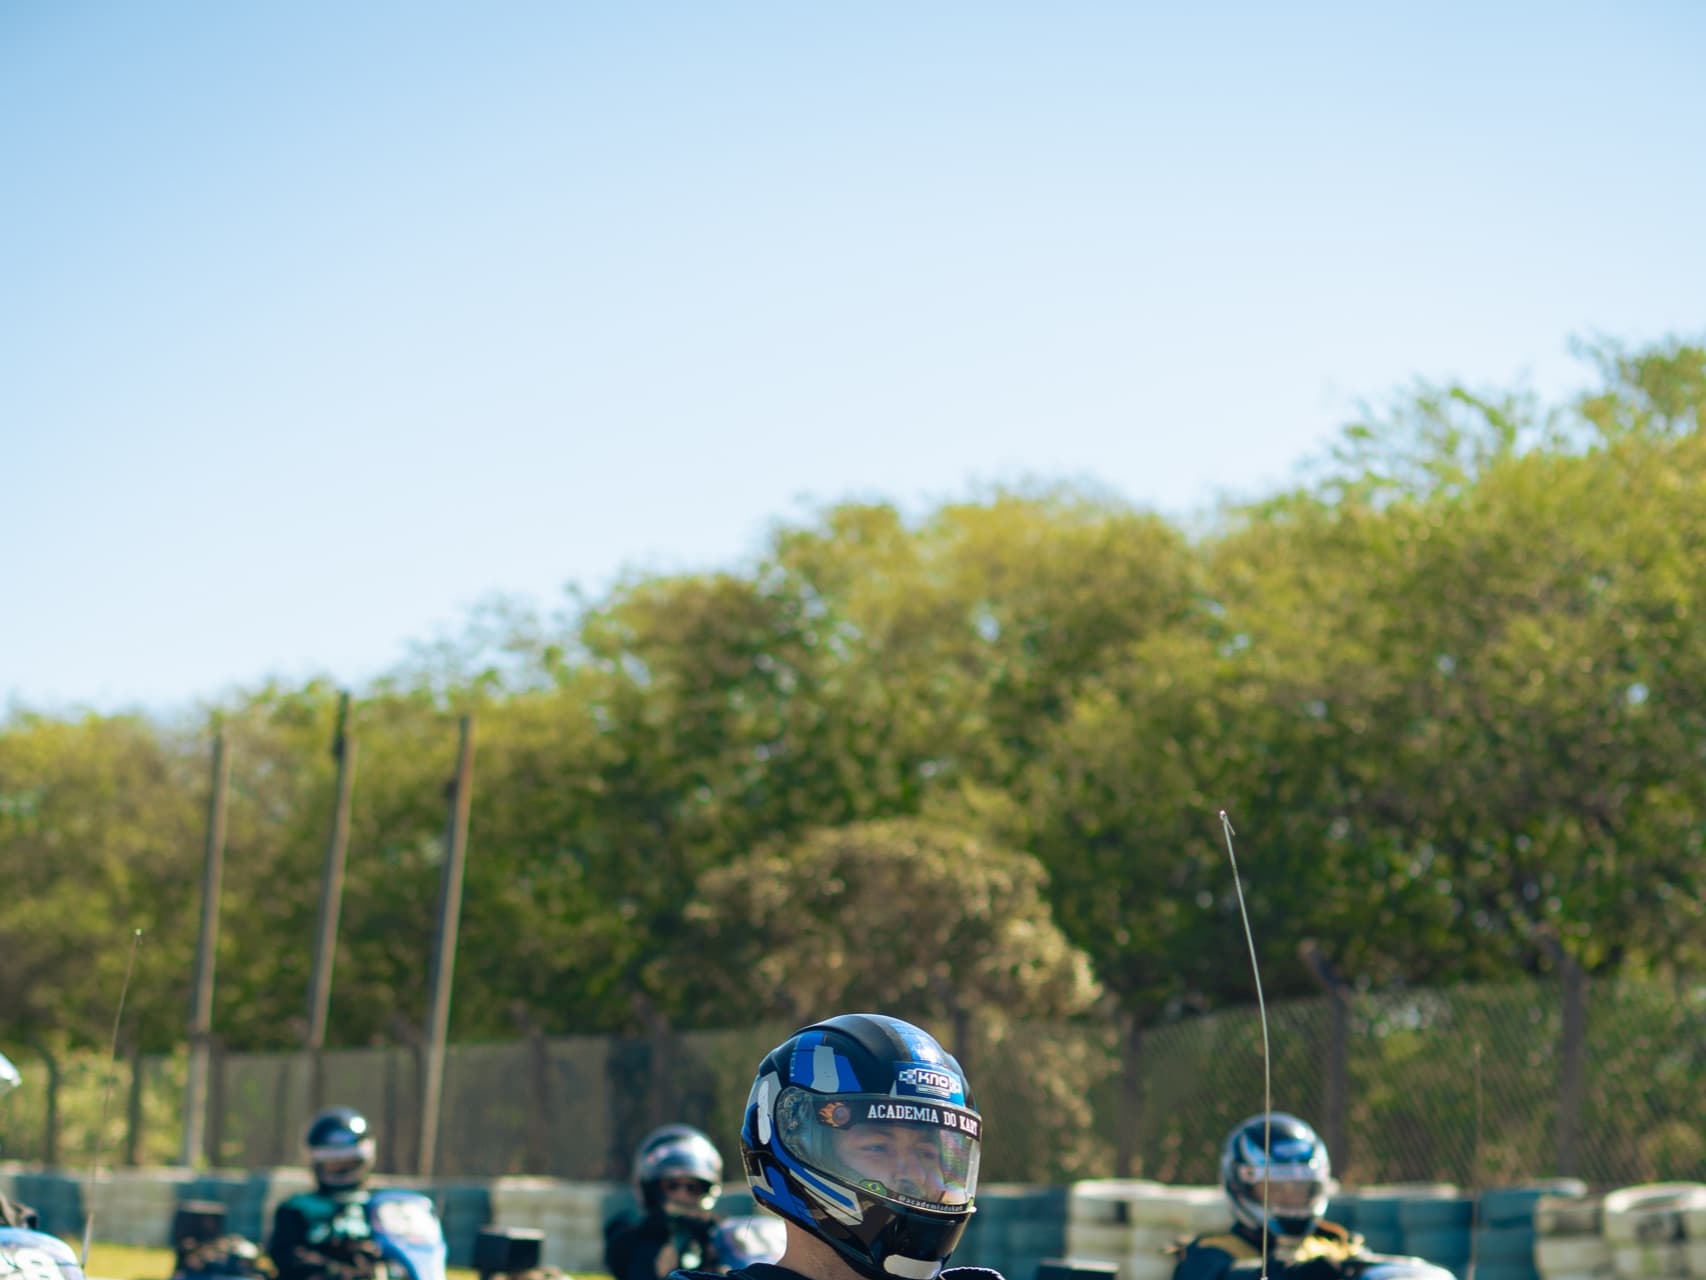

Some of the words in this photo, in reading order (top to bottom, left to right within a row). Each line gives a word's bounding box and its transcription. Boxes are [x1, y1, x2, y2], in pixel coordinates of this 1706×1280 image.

[867, 1104, 939, 1123] ACADEMIA
[943, 1111, 957, 1127] DO
[959, 1115, 978, 1136] KART
